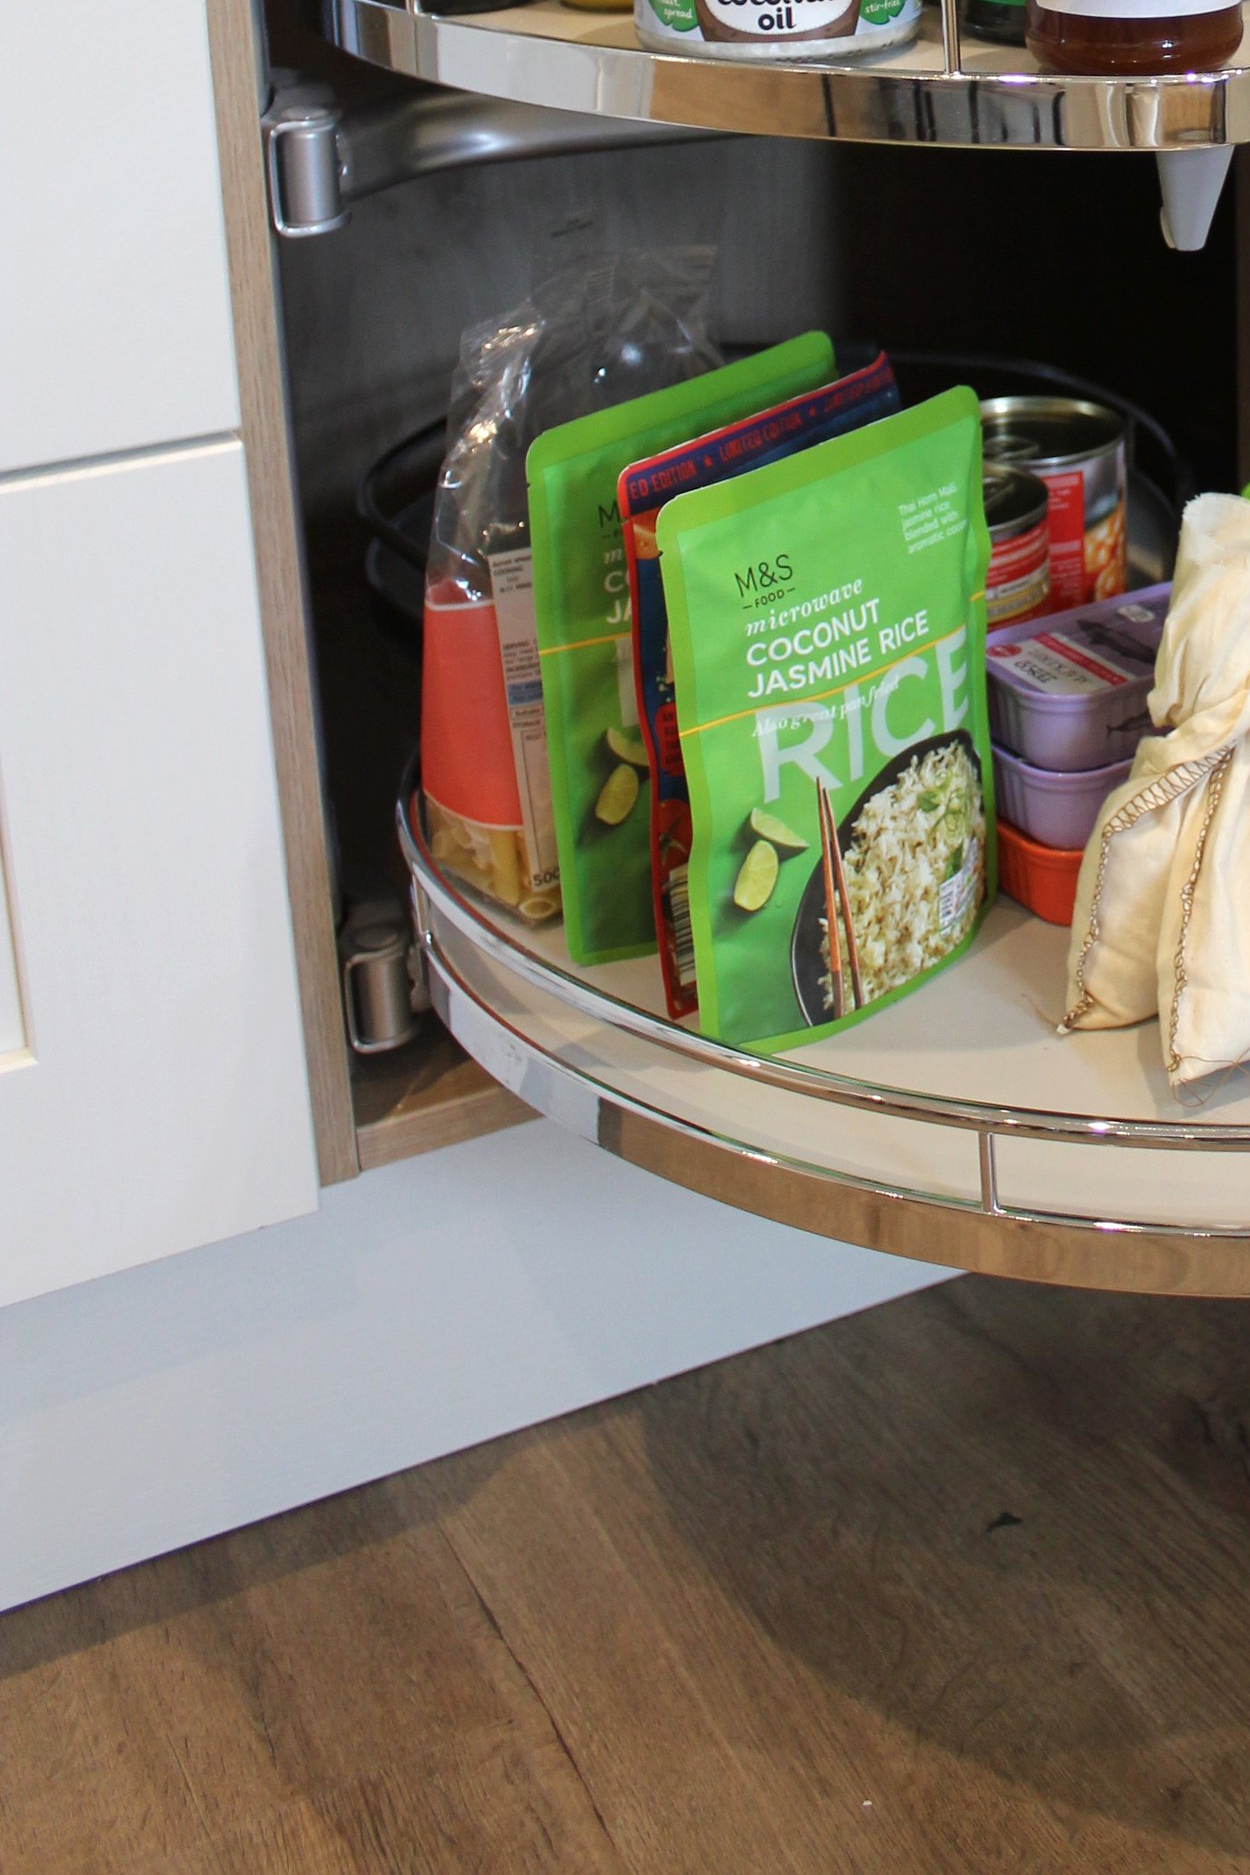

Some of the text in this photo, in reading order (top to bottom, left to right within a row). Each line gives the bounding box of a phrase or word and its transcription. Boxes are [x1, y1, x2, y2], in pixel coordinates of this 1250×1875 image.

[663, 8, 693, 20] spread
[758, 6, 796, 31] oil
[651, 458, 698, 493] EDITION
[718, 431, 764, 463] LIMITED
[734, 553, 795, 598] M&S
[754, 589, 785, 609] FOOD
[744, 578, 863, 637] microwave
[745, 597, 880, 667] COCONUT
[747, 609, 929, 698] JASMINE RICE
[754, 625, 970, 805] RICE
